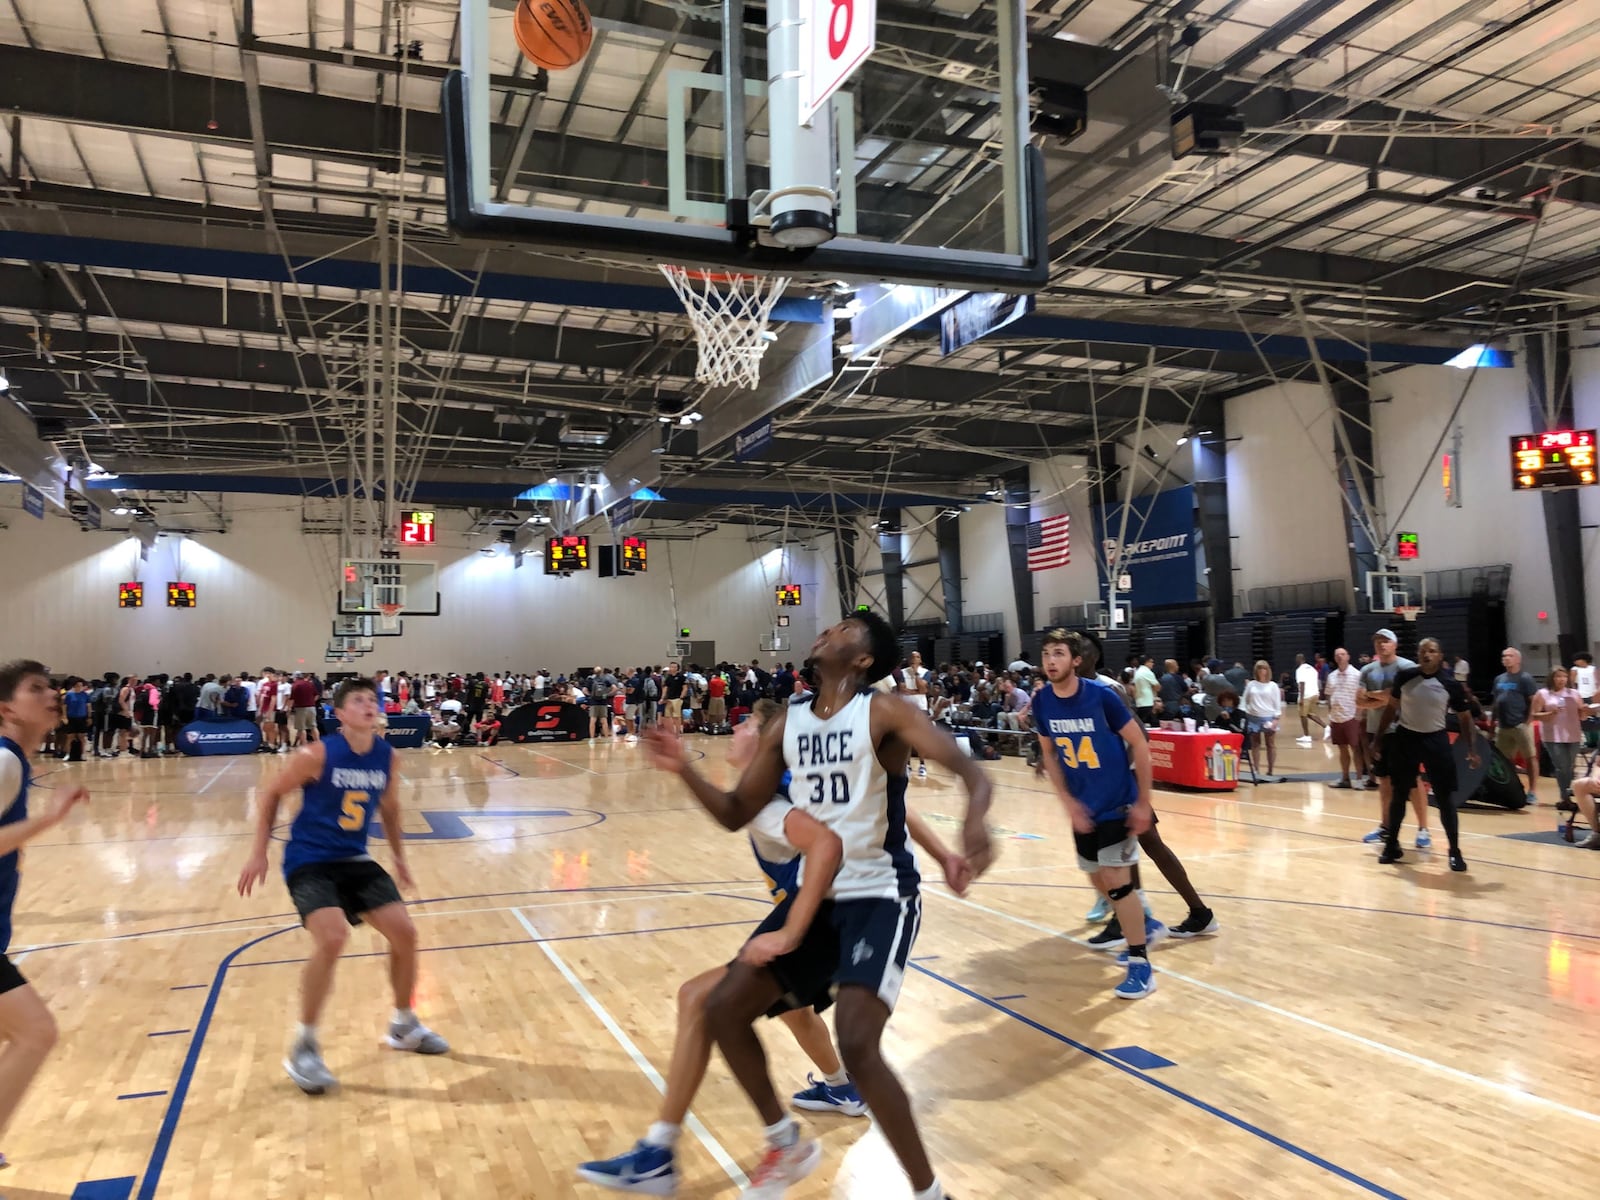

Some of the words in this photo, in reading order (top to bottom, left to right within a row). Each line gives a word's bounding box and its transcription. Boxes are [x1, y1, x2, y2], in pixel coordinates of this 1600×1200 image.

[404, 523, 430, 542] 21
[1049, 717, 1095, 734] ETOWAH
[797, 730, 853, 767] PACE
[1055, 735, 1101, 769] 34
[806, 771, 850, 804] 30
[337, 790, 370, 832] 5
